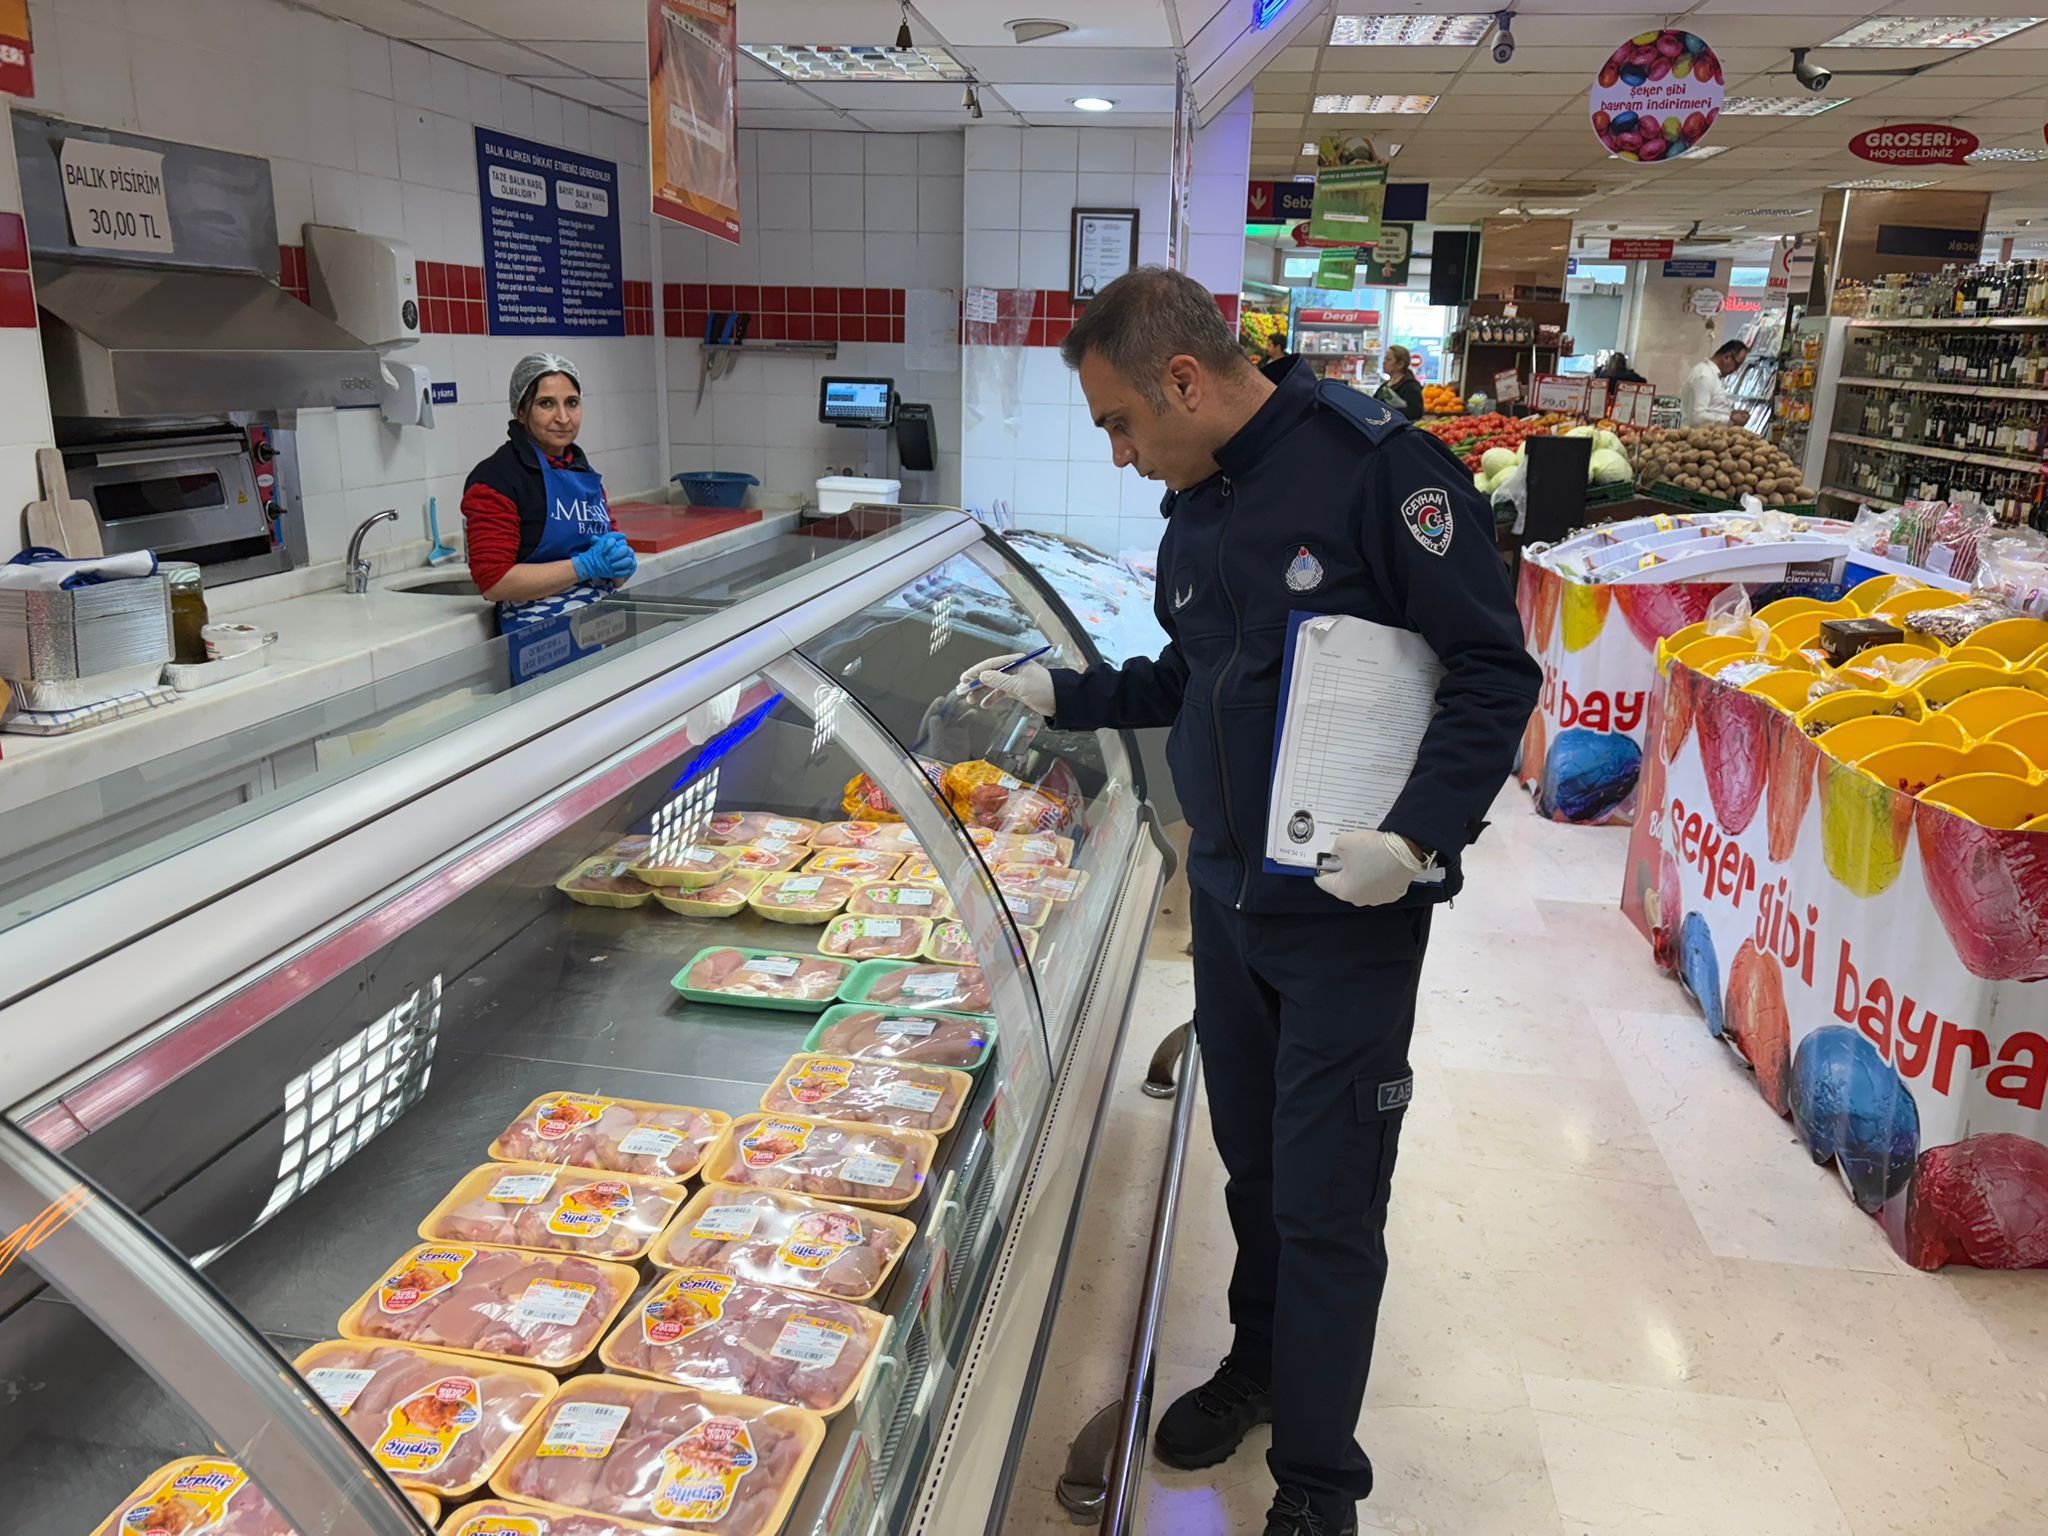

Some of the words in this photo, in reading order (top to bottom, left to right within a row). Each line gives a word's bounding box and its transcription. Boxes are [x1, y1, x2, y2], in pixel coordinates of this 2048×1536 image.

[1630, 85, 1663, 98] şeker
[1666, 84, 1687, 96] gibi
[1601, 101, 1643, 111] bayram
[1647, 97, 1712, 110] indirimleri
[485, 144, 504, 157] BALIK
[1869, 147, 1953, 160] HOŞGELDİNİZ
[66, 164, 108, 189] BALIK
[492, 171, 508, 183] TAZE
[509, 175, 526, 186] BALIK
[527, 178, 544, 190] NASIL
[575, 188, 590, 199] BALIK
[88, 208, 136, 240] 30,00
[139, 213, 161, 239] TL
[1405, 493, 1443, 516] CEYHAN
[1411, 523, 1439, 551] BELEDİYE
[1755, 875, 1819, 988] gibi
[1834, 938, 2048, 1111] bayra
[176, 1471, 235, 1491] erpiliç
